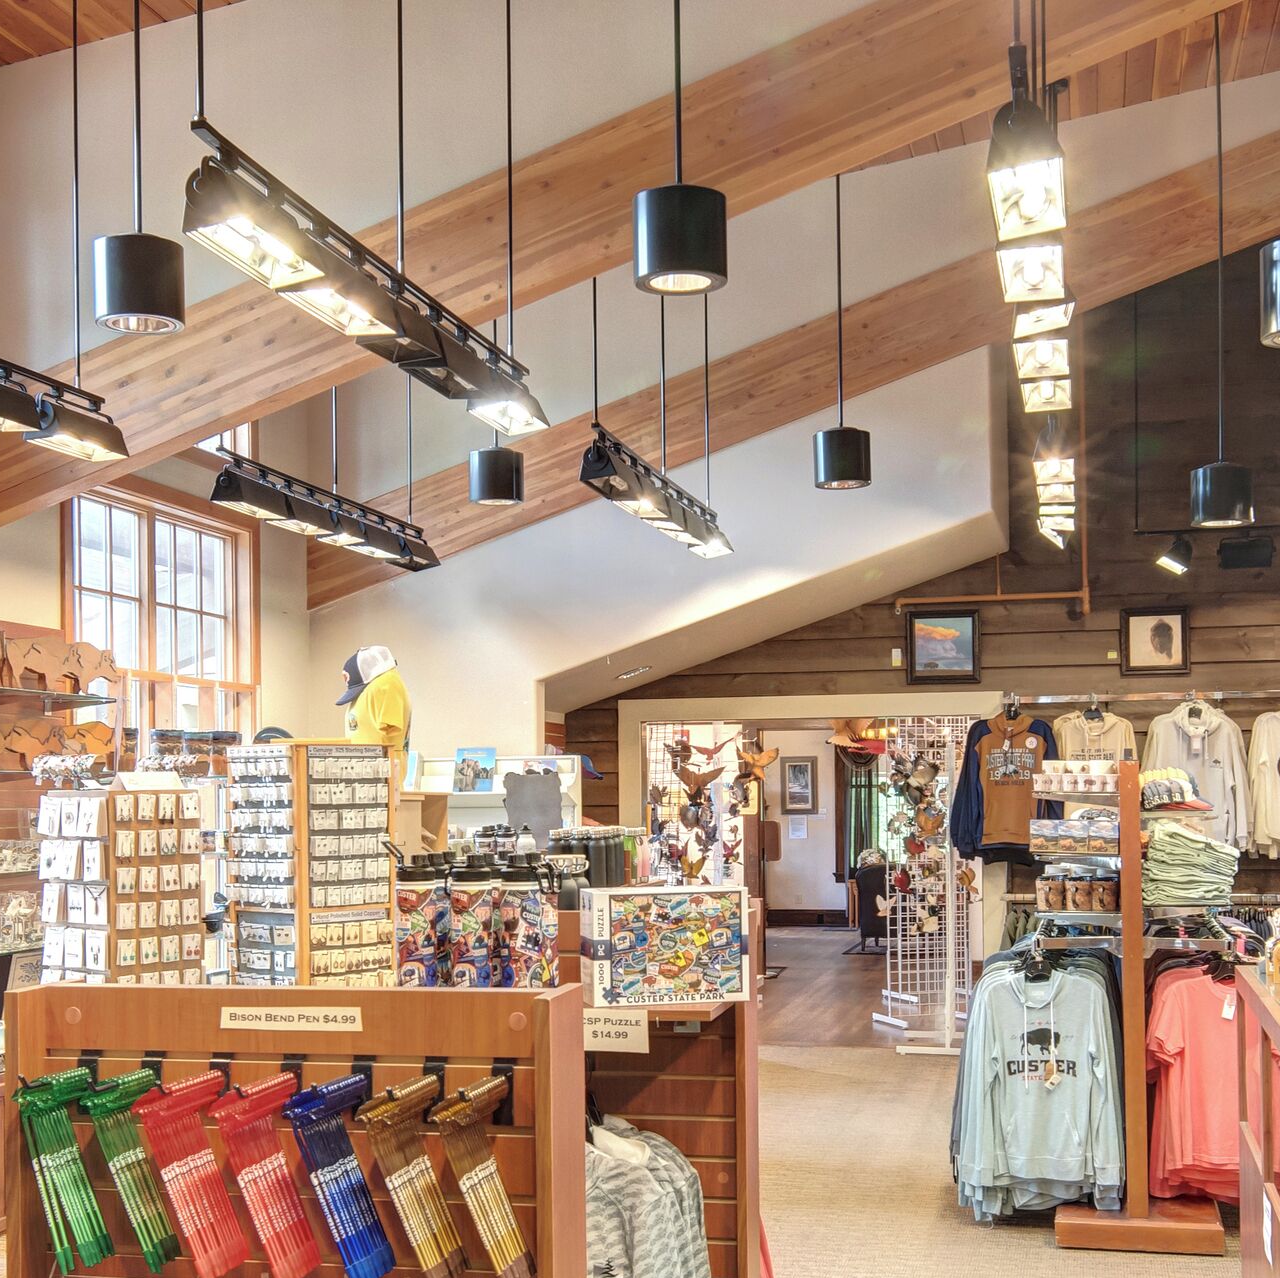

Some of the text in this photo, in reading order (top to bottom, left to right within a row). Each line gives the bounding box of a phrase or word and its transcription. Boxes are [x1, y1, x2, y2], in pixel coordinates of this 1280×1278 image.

[990, 770, 1001, 780] 19
[1019, 769, 1030, 780] 19
[397, 890, 417, 902] CUSTER
[523, 911, 540, 922] CUSTE
[598, 944, 605, 956] PC
[626, 992, 726, 1004] CUSTER STATE PARK
[229, 1012, 357, 1024] BISON BEND PEN $4.99
[604, 1017, 642, 1027] PUZZLE
[592, 1030, 629, 1040] $14.99
[1007, 1059, 1077, 1078] CUSTER
